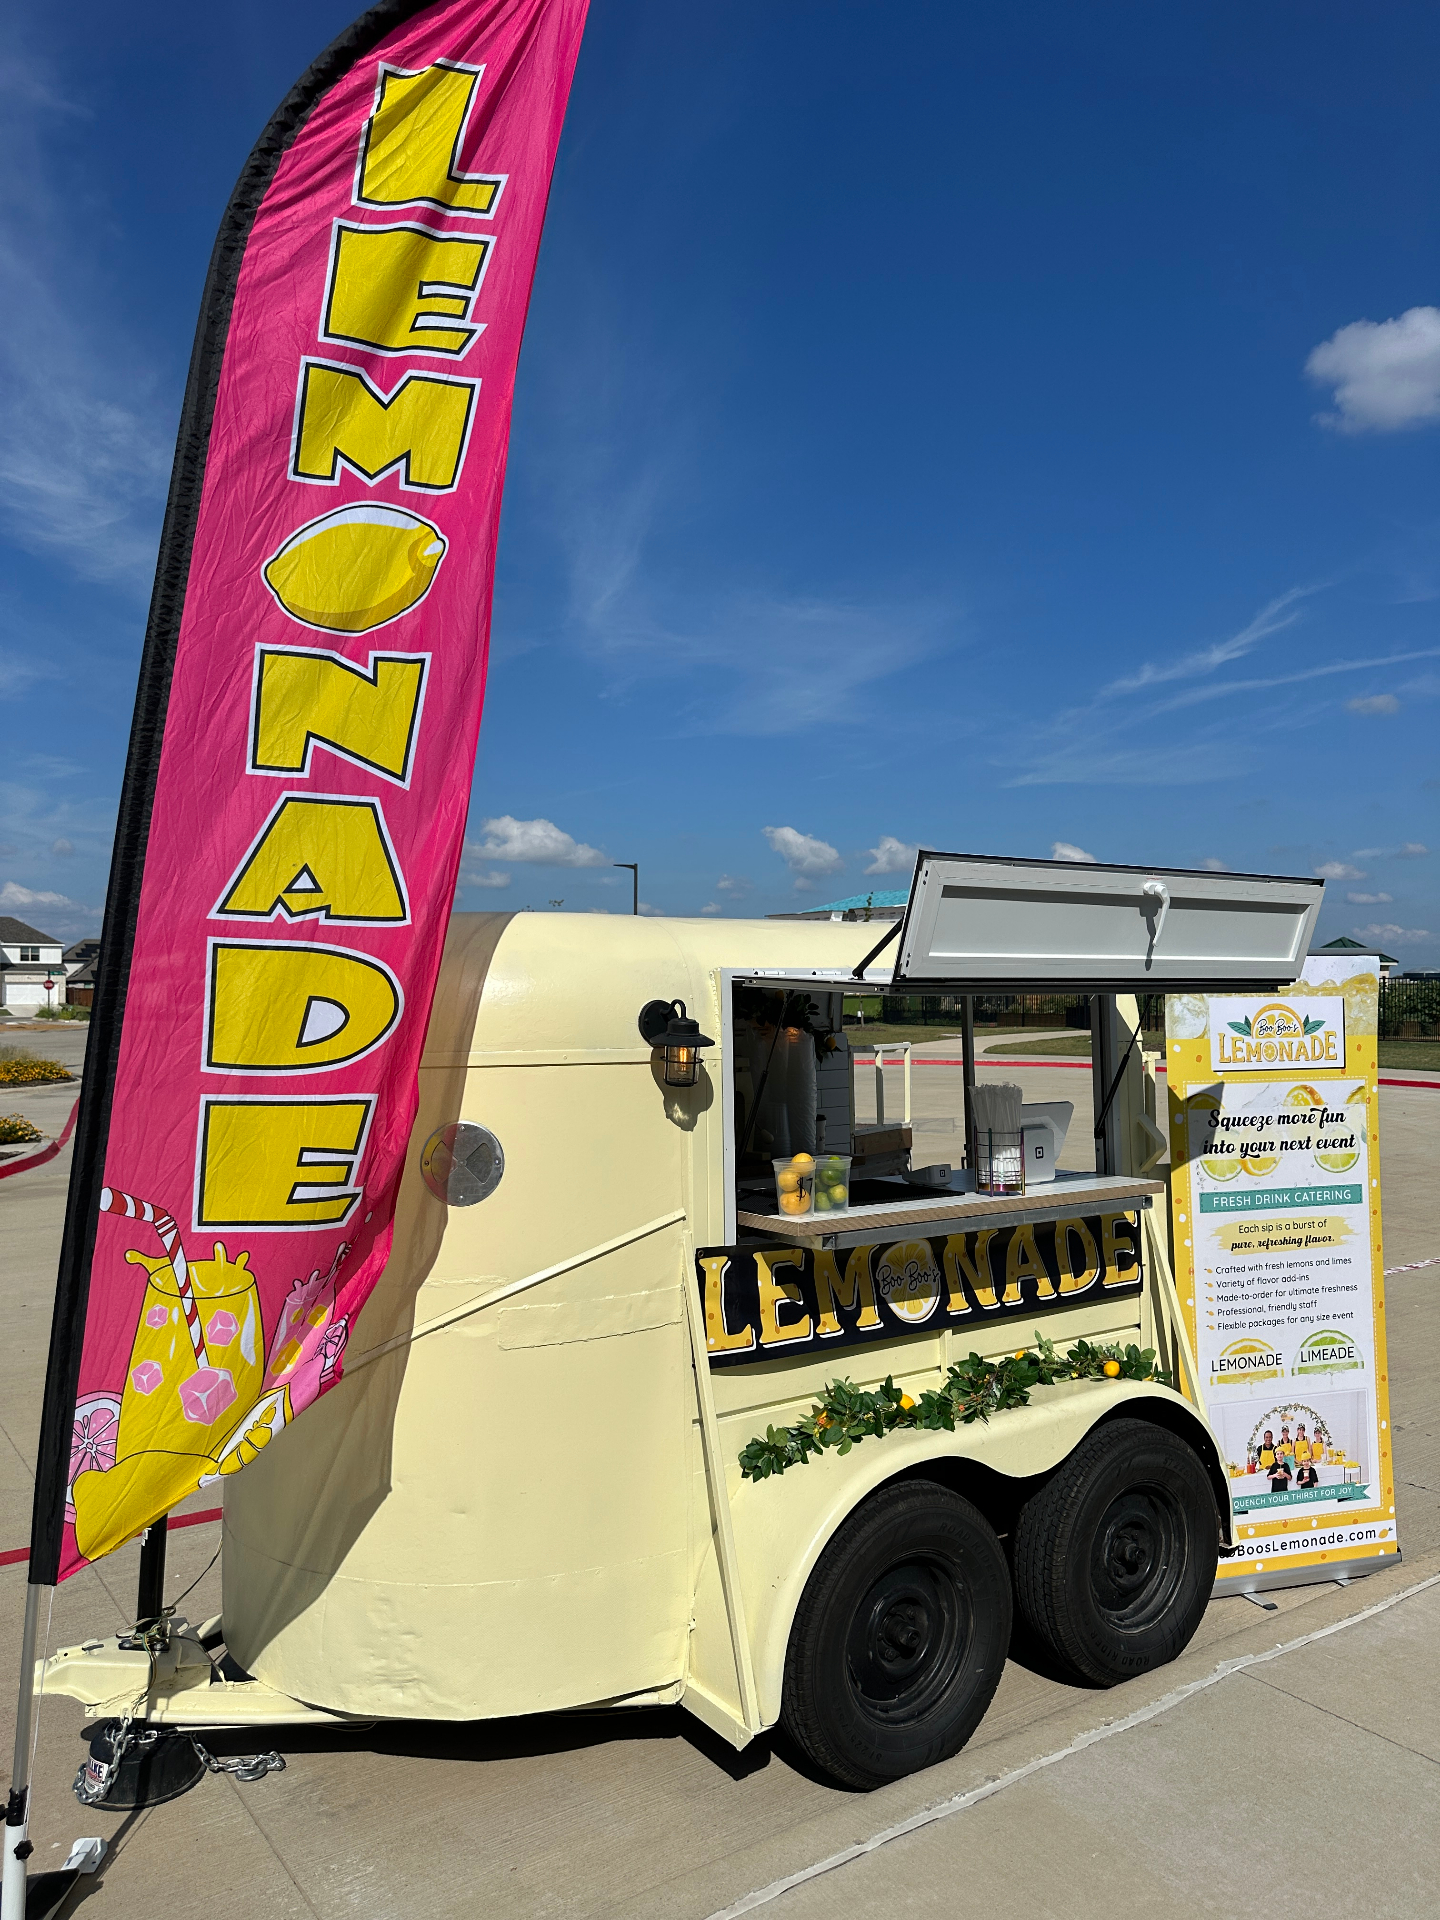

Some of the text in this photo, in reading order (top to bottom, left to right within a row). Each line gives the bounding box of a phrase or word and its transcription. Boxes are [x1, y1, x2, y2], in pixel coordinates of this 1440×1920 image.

[1256, 1018, 1299, 1036] Boo Boo's
[1218, 1031, 1337, 1063] LEMONADE
[1208, 1107, 1346, 1132] Squeeze more fun
[1203, 1134, 1356, 1159] into your next event
[1213, 1190, 1352, 1208] FRESH DRINK CATERING
[1238, 1224, 1260, 1234] Each
[1261, 1222, 1274, 1232] sip
[1276, 1222, 1283, 1231] is
[1292, 1220, 1316, 1230] burst
[1318, 1218, 1328, 1228] of
[1230, 1234, 1335, 1252] pure, refreshing flavor.
[1216, 1264, 1246, 1274] Crafted
[1248, 1263, 1264, 1272] with
[1264, 1261, 1284, 1270] fresh
[1286, 1260, 1314, 1268] lemons
[1316, 1258, 1330, 1266] and
[877, 1260, 940, 1295] Boo Boo's
[1216, 1274, 1310, 1288] Variety of flavor add-ins
[1216, 1284, 1358, 1302] Made-to-order for ultimate freshness
[1218, 1300, 1318, 1316] Professional, friendly staff
[1218, 1311, 1354, 1330] Flexible packages for any size event
[1211, 1352, 1283, 1372] LEMONADE
[1300, 1346, 1354, 1362] LIMEADE
[1234, 1486, 1352, 1509] QUENCH YOUR THIRST FOR JOY
